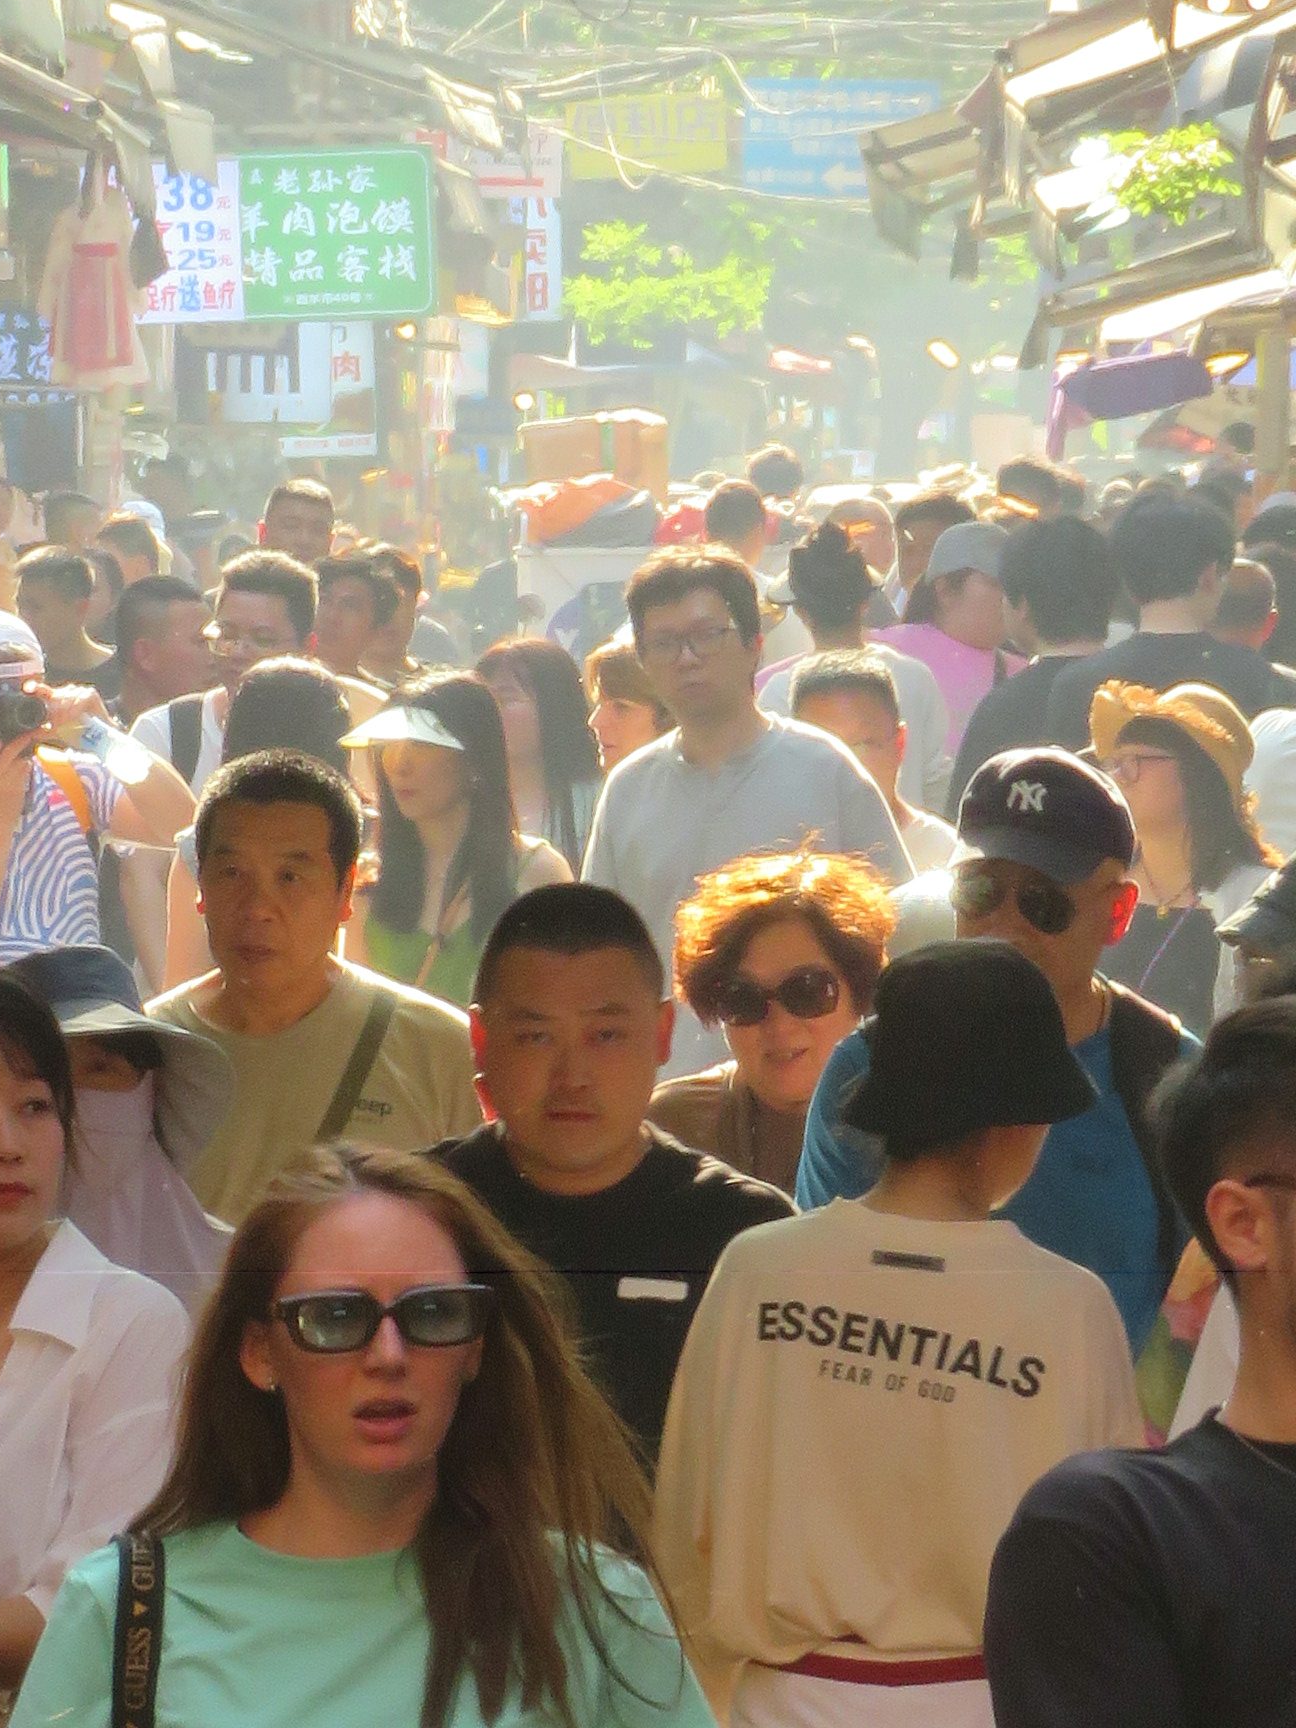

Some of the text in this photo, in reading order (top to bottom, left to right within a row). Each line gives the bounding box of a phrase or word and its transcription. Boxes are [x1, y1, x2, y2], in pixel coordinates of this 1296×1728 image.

[273, 165, 378, 195] 老孙家
[241, 196, 416, 242] 羊肉泡馍
[244, 243, 418, 287] 精品客栈
[757, 1300, 1046, 1399] ESSENTIALS
[818, 1358, 958, 1404] FEAR OF GOD
